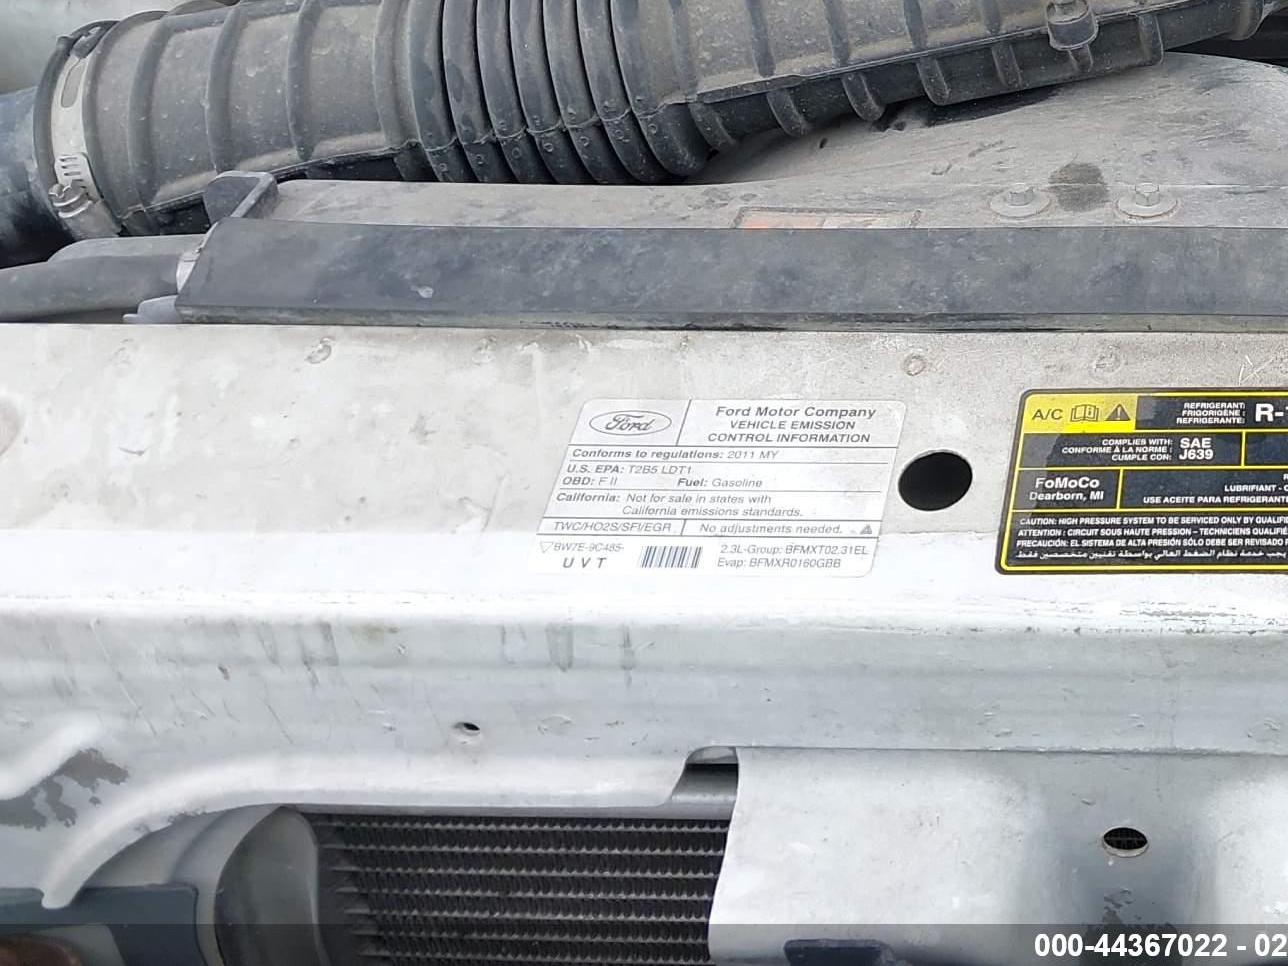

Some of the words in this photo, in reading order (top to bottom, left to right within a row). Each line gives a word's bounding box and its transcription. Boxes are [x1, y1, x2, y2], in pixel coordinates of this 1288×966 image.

[716, 407, 751, 416] Ford
[756, 407, 800, 417] Motor
[804, 407, 876, 419] Company
[1032, 409, 1064, 420] A/C
[605, 413, 655, 431] Ford
[730, 421, 786, 429] VEHICLE
[791, 422, 856, 430] EMISSION
[708, 434, 773, 442] CONTROL
[777, 434, 870, 442] INFORMATION
[1180, 438, 1211, 448] SAE
[573, 449, 631, 458] Conforms
[635, 449, 647, 458] to
[651, 449, 723, 460] regulations:
[727, 451, 754, 459] 2011
[759, 451, 779, 459] MY
[1179, 450, 1213, 460] J639
[567, 465, 590, 473] U.S.
[595, 465, 625, 474] EPA:
[629, 466, 658, 474] T2B5
[661, 466, 692, 474] LDT1
[563, 477, 594, 485] OBD:
[677, 478, 708, 487] Fuel:
[711, 479, 762, 488] Gasoline
[1035, 478, 1100, 488] FoMoCo
[557, 493, 620, 502] California:
[626, 493, 647, 502] Not
[650, 493, 665, 503] for
[668, 494, 692, 503] sale
[696, 494, 706, 503] in
[709, 495, 744, 503] states
[749, 495, 771, 503] with
[1029, 492, 1086, 501] Dearborn,
[1090, 492, 1104, 500] MI
[622, 505, 676, 515] California
[681, 506, 739, 516] emissions
[742, 507, 803, 517] standards.
[700, 524, 716, 532] No
[720, 524, 792, 534] adjustments
[795, 524, 843, 534] needed.
[720, 545, 783, 555] 2.3L-Group:
[718, 558, 747, 568] Evap:
